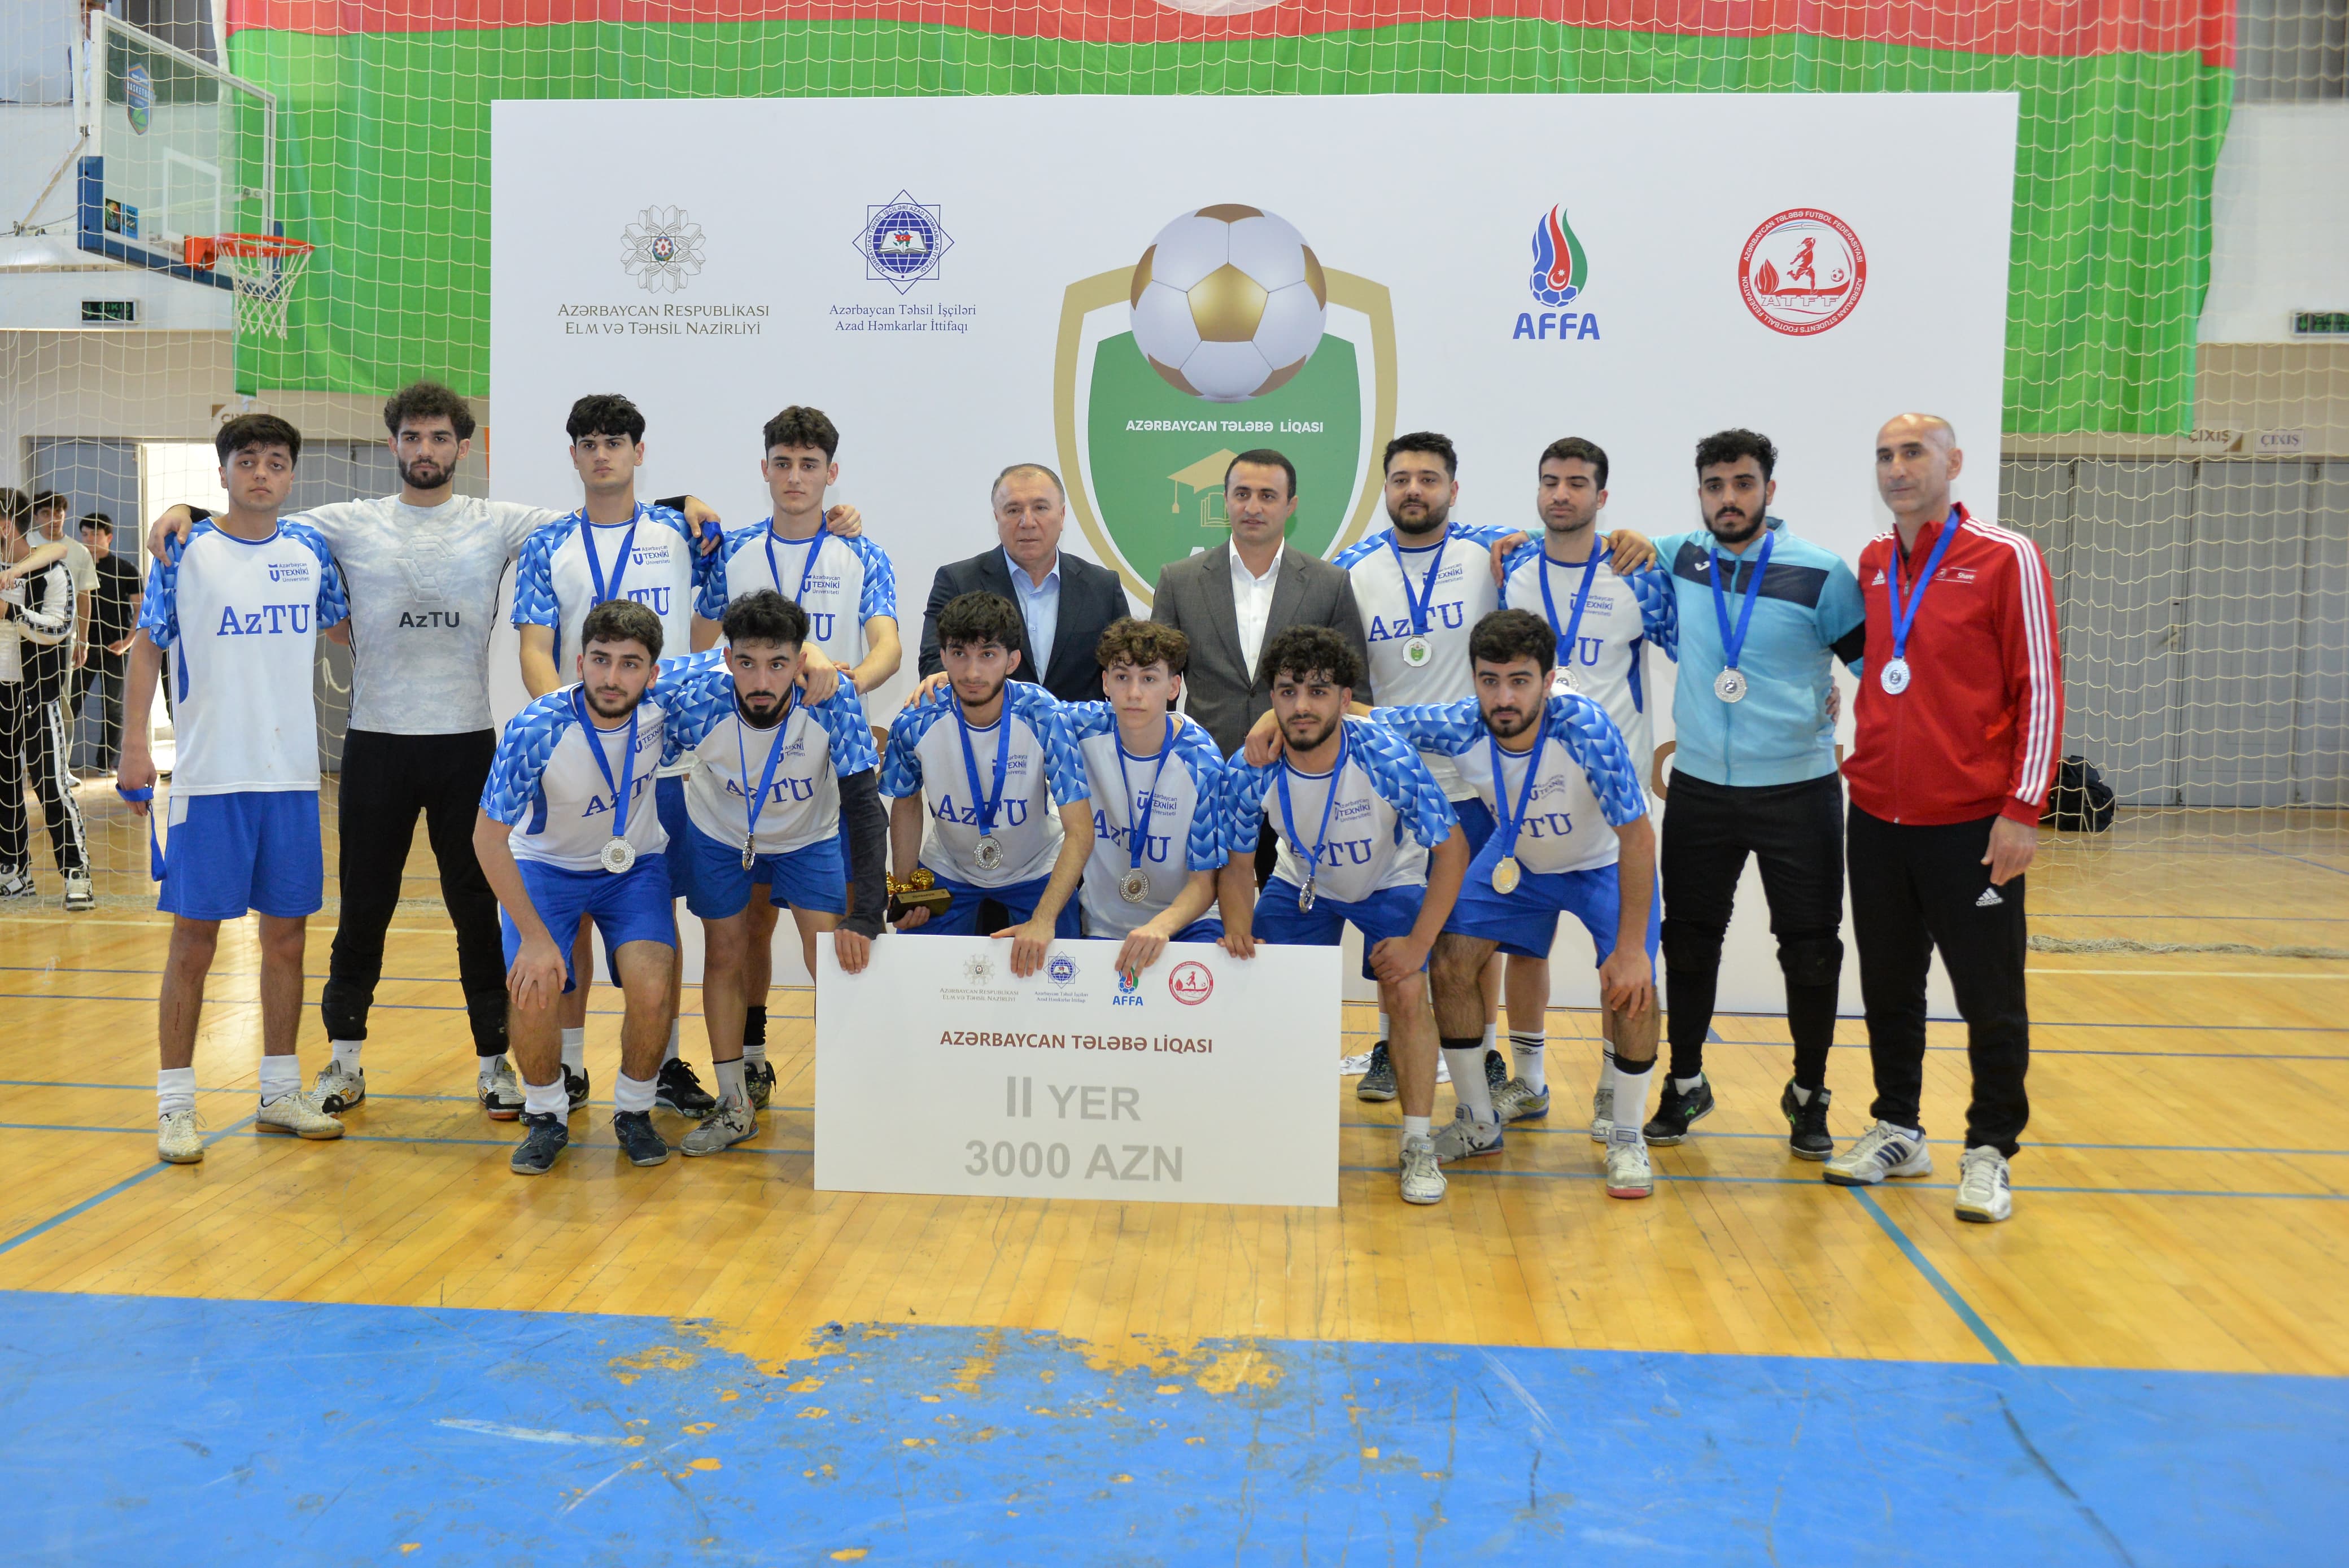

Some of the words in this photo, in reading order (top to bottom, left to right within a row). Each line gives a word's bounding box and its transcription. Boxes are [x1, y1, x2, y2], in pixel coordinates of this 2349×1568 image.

[909, 207, 925, 216] AZAD
[869, 215, 884, 234] TƏHSİL
[924, 215, 940, 251] HƏMKARLAR
[1743, 220, 1775, 262] AZƏRBAYCAN
[1775, 211, 1803, 224] TƏLƏBƏ
[1805, 211, 1832, 224] FUTBOL
[1832, 220, 1863, 263] FEDERASİYASI
[867, 234, 886, 273] AZƏRBAYCAN
[1741, 276, 1764, 317] FEDERATION
[1761, 295, 1840, 307] ATFF
[1838, 277, 1863, 318] AZERBAIJAN
[558, 304, 660, 317] AZƏRBAYCAN
[829, 304, 895, 317] Azərbaycan
[898, 304, 933, 315] Təhsil
[938, 303, 976, 317] İşçiləri
[566, 322, 599, 335] ELM
[628, 321, 682, 335] TƏHSİL
[687, 321, 761, 335] NAZİRLİYİ
[835, 321, 864, 331] Azad
[867, 320, 927, 331] Həmkarlar
[931, 318, 968, 334] İttifaqı
[1513, 313, 1600, 340] AFFA
[1764, 315, 1798, 333] FOOTBALL
[1126, 420, 1217, 431] AZƏRBAYCAN
[1220, 421, 1274, 432] TƏLƏBƏ
[1281, 418, 1324, 434] LİQASI
[1438, 567, 1463, 579] EXNİKİ
[1586, 601, 1613, 610] EXNİKİ
[217, 604, 310, 636] AzTU
[399, 612, 460, 628] AzTU
[1112, 995, 1143, 1006] AFFA
[940, 1031, 1065, 1049] AZƏRBAYCAN
[1071, 1035, 1147, 1051] TƏLƏBƏ
[1154, 1034, 1212, 1054] LİQASI
[1007, 1076, 1032, 1118] II
[1047, 1084, 1142, 1121] YER
[964, 1139, 1071, 1179] 3000
[1084, 1144, 1183, 1182] AZN
